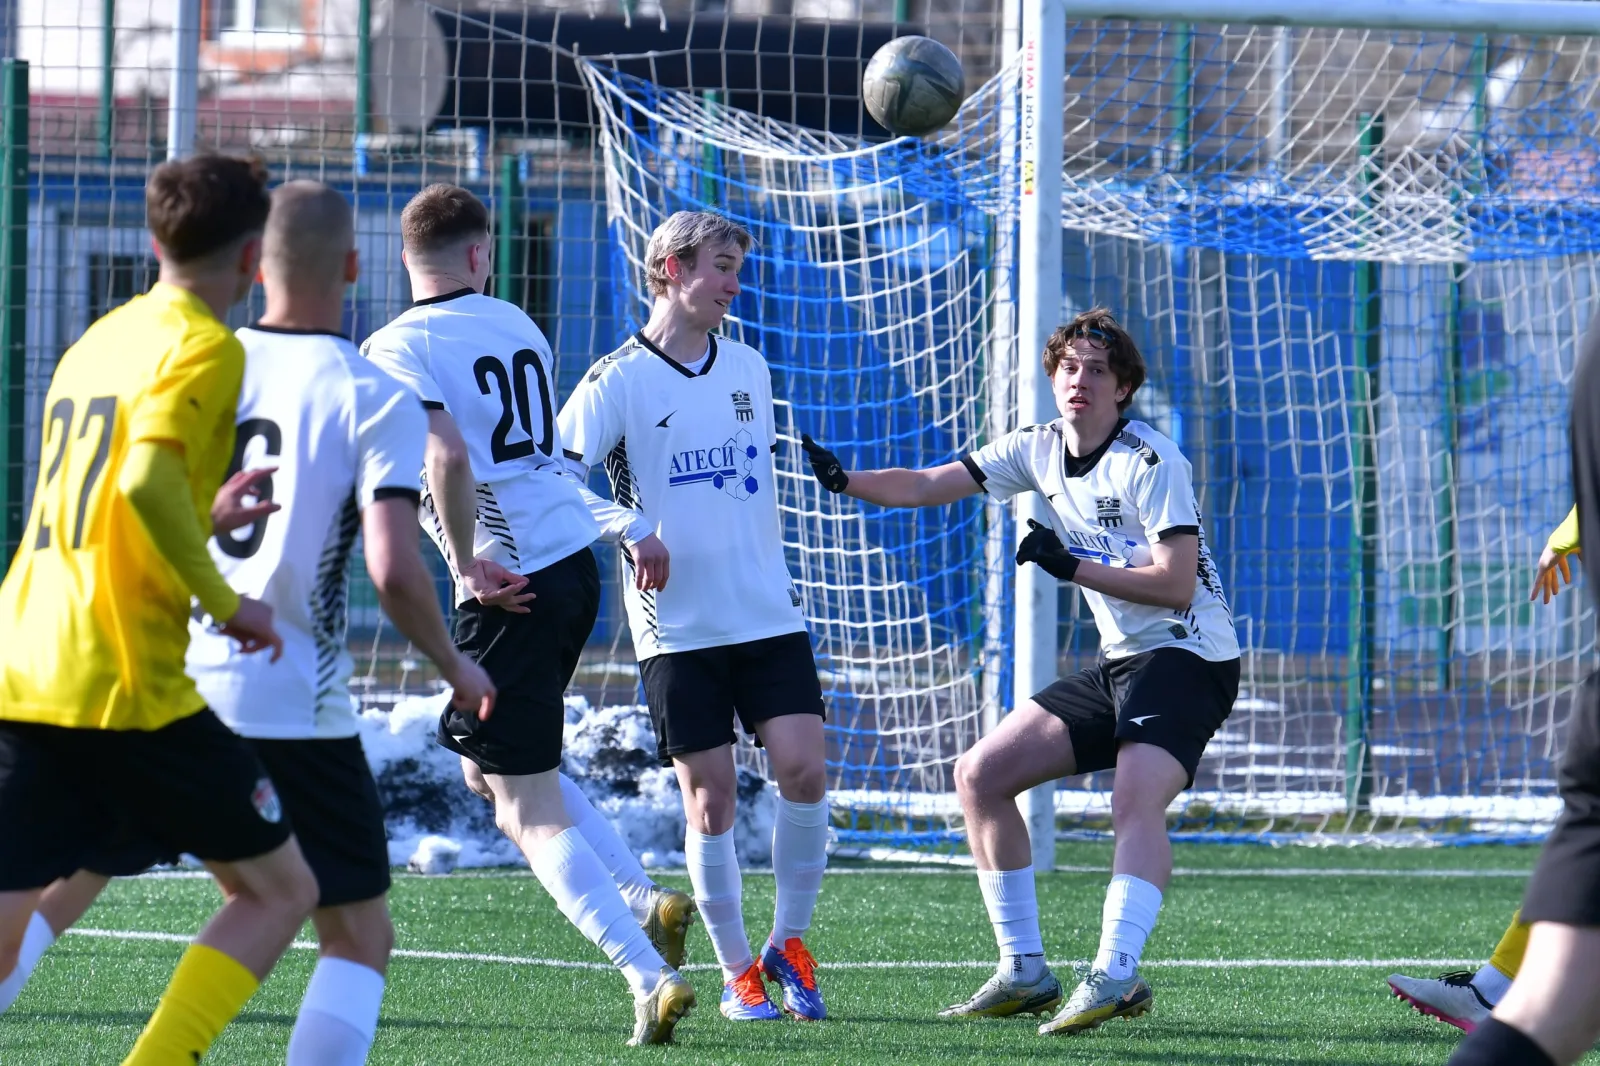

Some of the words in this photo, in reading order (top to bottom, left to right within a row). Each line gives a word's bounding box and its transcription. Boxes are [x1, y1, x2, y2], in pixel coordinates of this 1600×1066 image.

[34, 395, 118, 551] 27
[473, 349, 554, 464] 20
[214, 418, 282, 559] 6
